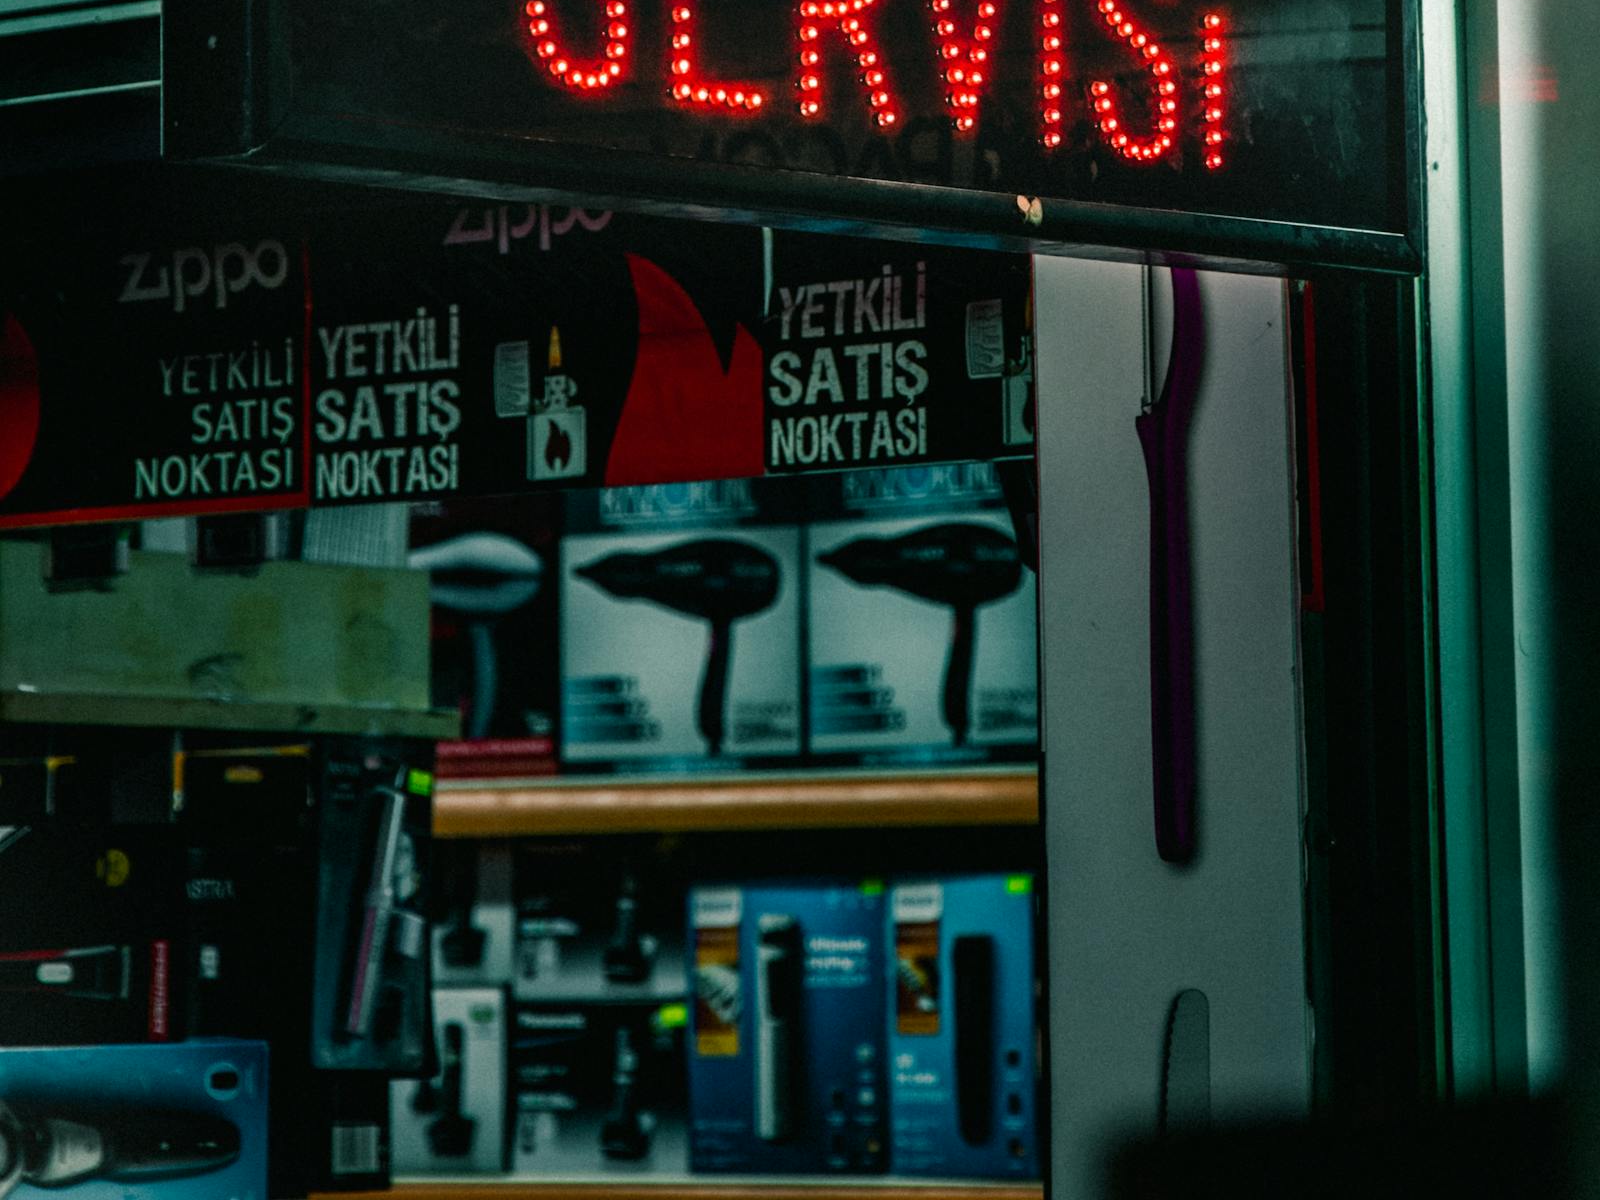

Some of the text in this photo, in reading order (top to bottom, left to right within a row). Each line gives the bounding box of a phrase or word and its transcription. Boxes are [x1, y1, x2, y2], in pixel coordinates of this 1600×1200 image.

[778, 260, 928, 341] YETKİLİ
[157, 337, 294, 397] YETKİLİ
[317, 303, 461, 381] YETKİLİ
[768, 339, 930, 409] SATIŞ
[191, 394, 295, 444] SATIŞ
[315, 378, 463, 442] SATIŞ
[770, 405, 928, 467] NOKTASI
[133, 447, 294, 499] NOKTASI
[315, 442, 460, 500] NOKTASI
